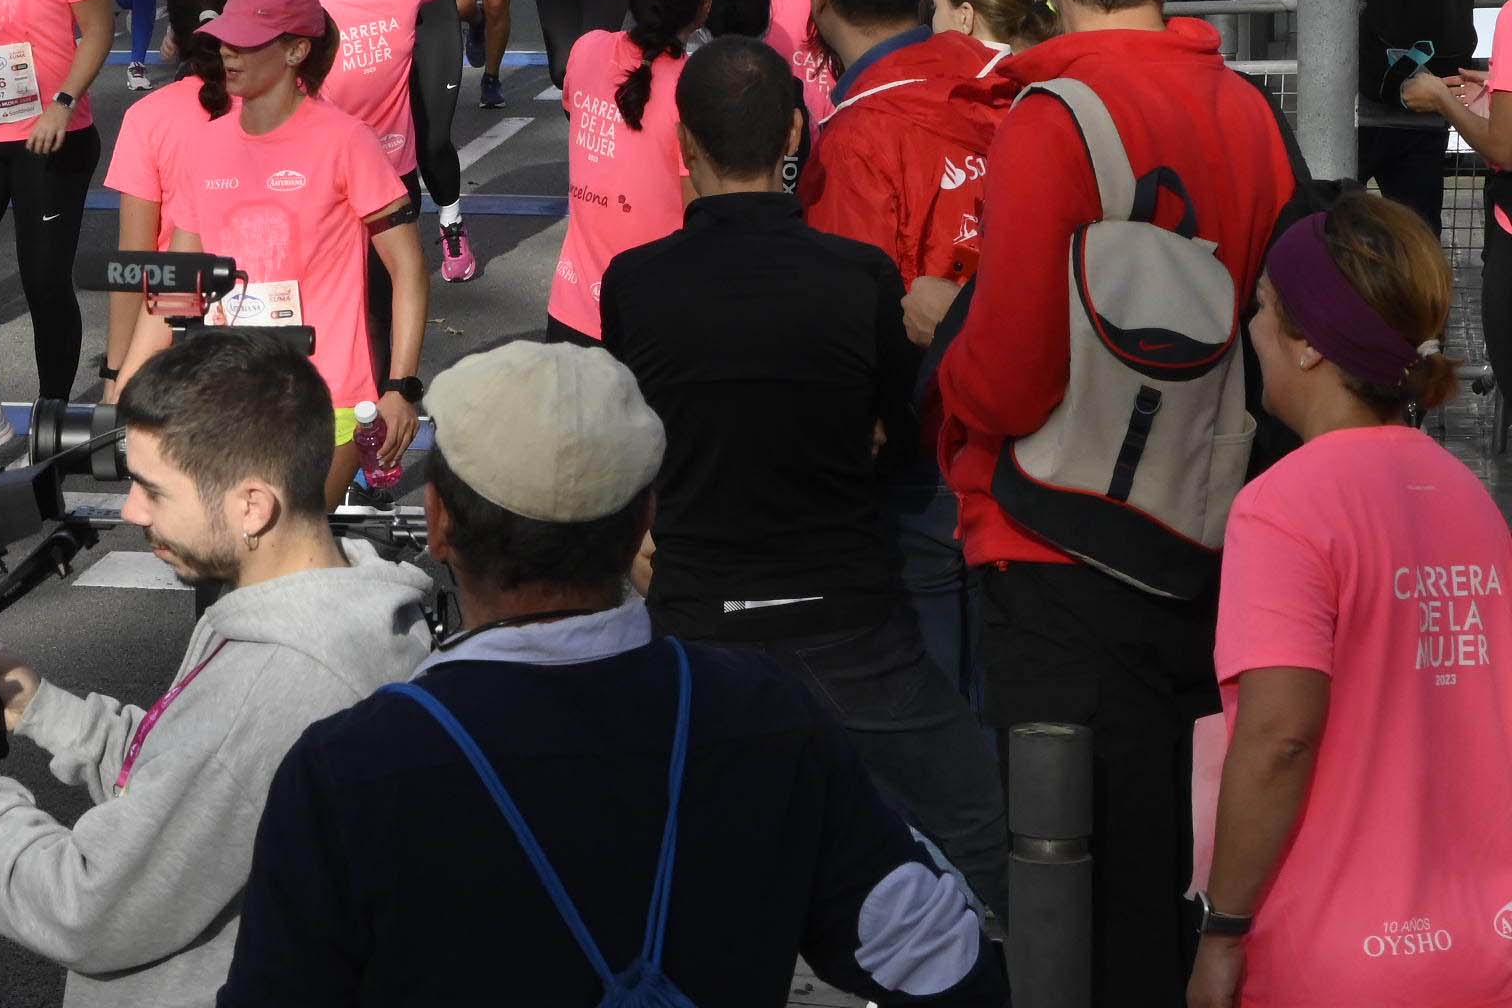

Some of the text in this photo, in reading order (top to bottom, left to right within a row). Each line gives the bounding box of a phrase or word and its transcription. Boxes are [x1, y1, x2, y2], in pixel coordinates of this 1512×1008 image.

[339, 17, 400, 43] ARRERA
[342, 35, 388, 57] DE LA
[342, 47, 392, 73] MUJER
[573, 91, 625, 124] CARRE
[580, 112, 616, 140] DE LA
[576, 132, 616, 159] MUJER
[569, 183, 608, 209] rcelona
[107, 261, 176, 287] RØDE
[1393, 564, 1503, 601] CARRERA
[1417, 600, 1484, 634] DE LA
[1414, 634, 1491, 670] MUJER
[1435, 674, 1457, 687] 2023
[1382, 916, 1431, 933] 10 AÑOS
[1362, 928, 1453, 959] OYSHO
